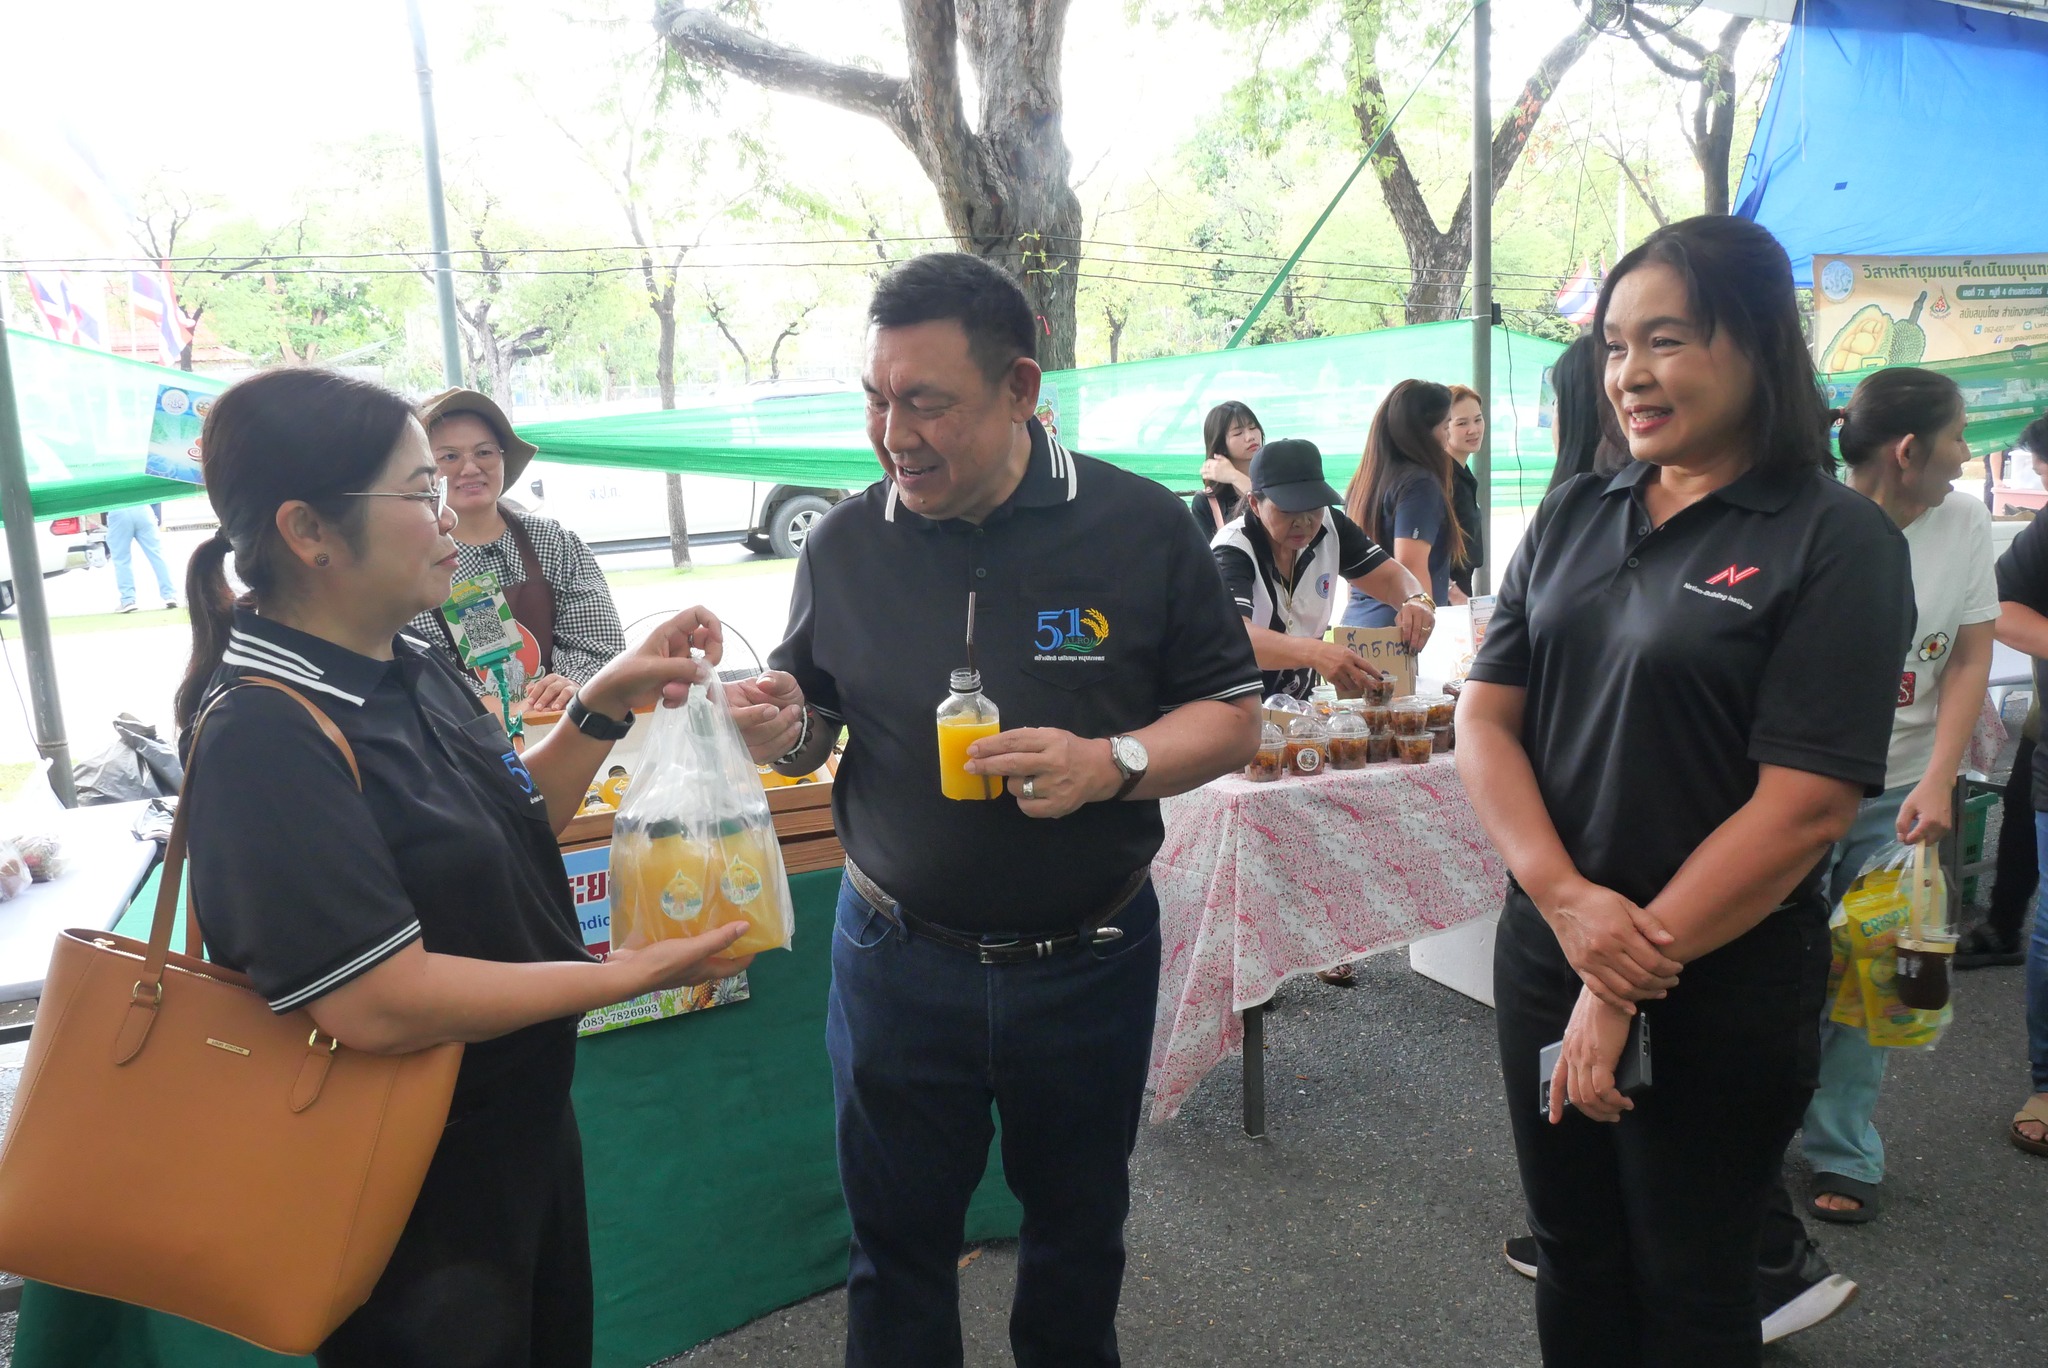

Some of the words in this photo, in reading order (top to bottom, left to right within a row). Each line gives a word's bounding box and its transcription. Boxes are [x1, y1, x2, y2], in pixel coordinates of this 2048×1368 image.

[1862, 260, 2048, 283] วิสาหกิจชุมชนเจ็ดเนินขนุนท
[1034, 607, 1086, 651] 51
